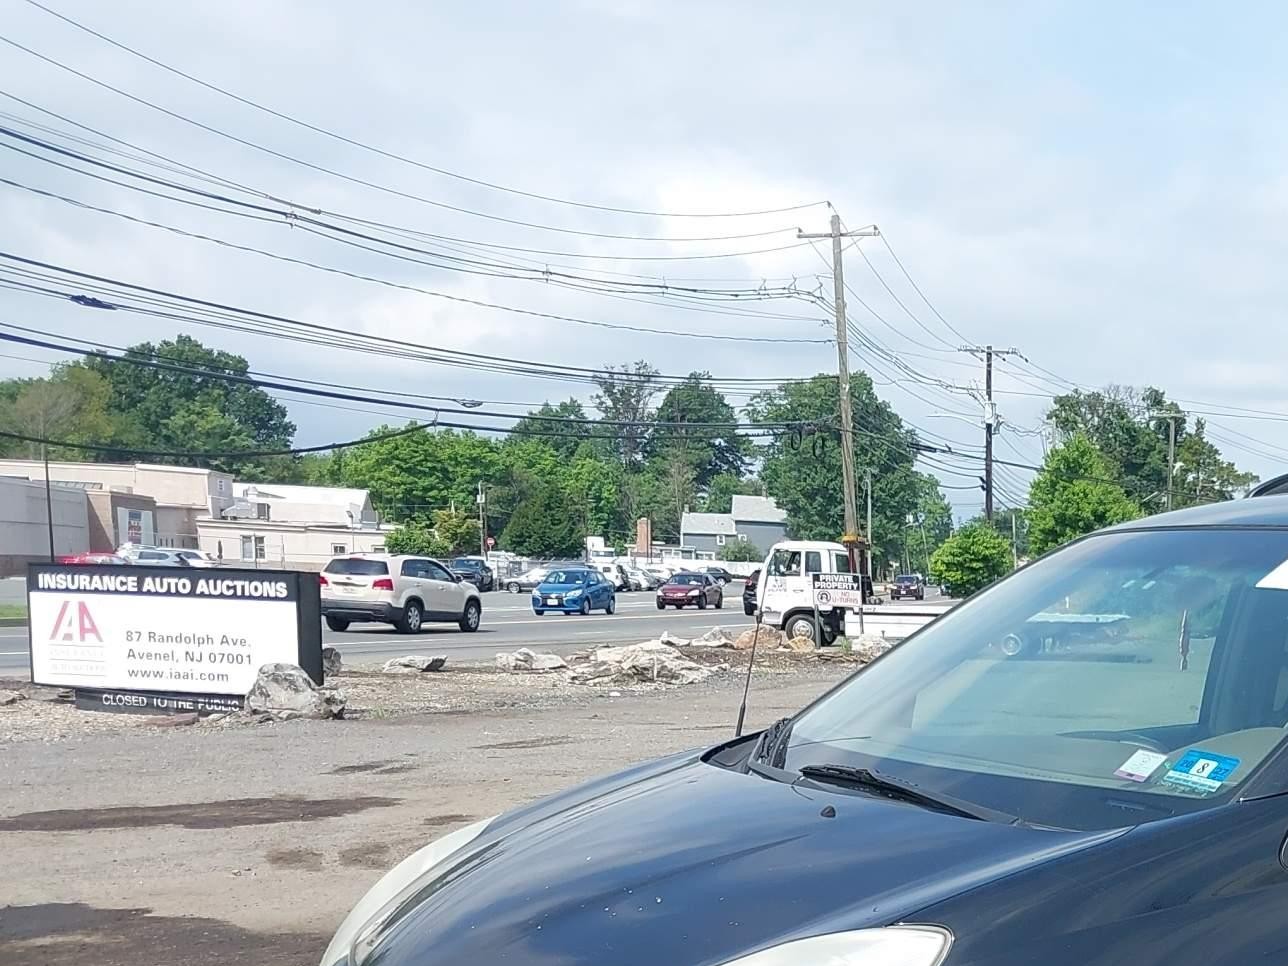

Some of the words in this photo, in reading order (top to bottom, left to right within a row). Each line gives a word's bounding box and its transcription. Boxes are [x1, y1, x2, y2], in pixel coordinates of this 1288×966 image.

[38, 573, 138, 592] INSURANCE
[142, 577, 191, 594] AUTO
[196, 579, 288, 598] AUCTIONS
[814, 581, 858, 590] PROPERTY
[819, 574, 854, 582] PRIVATE
[125, 630, 142, 642] 87
[148, 631, 214, 648] Randolph
[220, 634, 252, 648] Ave.
[127, 649, 179, 663] Avenel,
[185, 651, 203, 663] NJ
[208, 652, 251, 665] 07001
[127, 668, 229, 683] www.iaai.com
[102, 694, 147, 707] CLOSED
[153, 698, 168, 708] TO
[173, 699, 194, 710] THE
[198, 698, 240, 711] PUBLIC
[1196, 762, 1210, 774] 8
